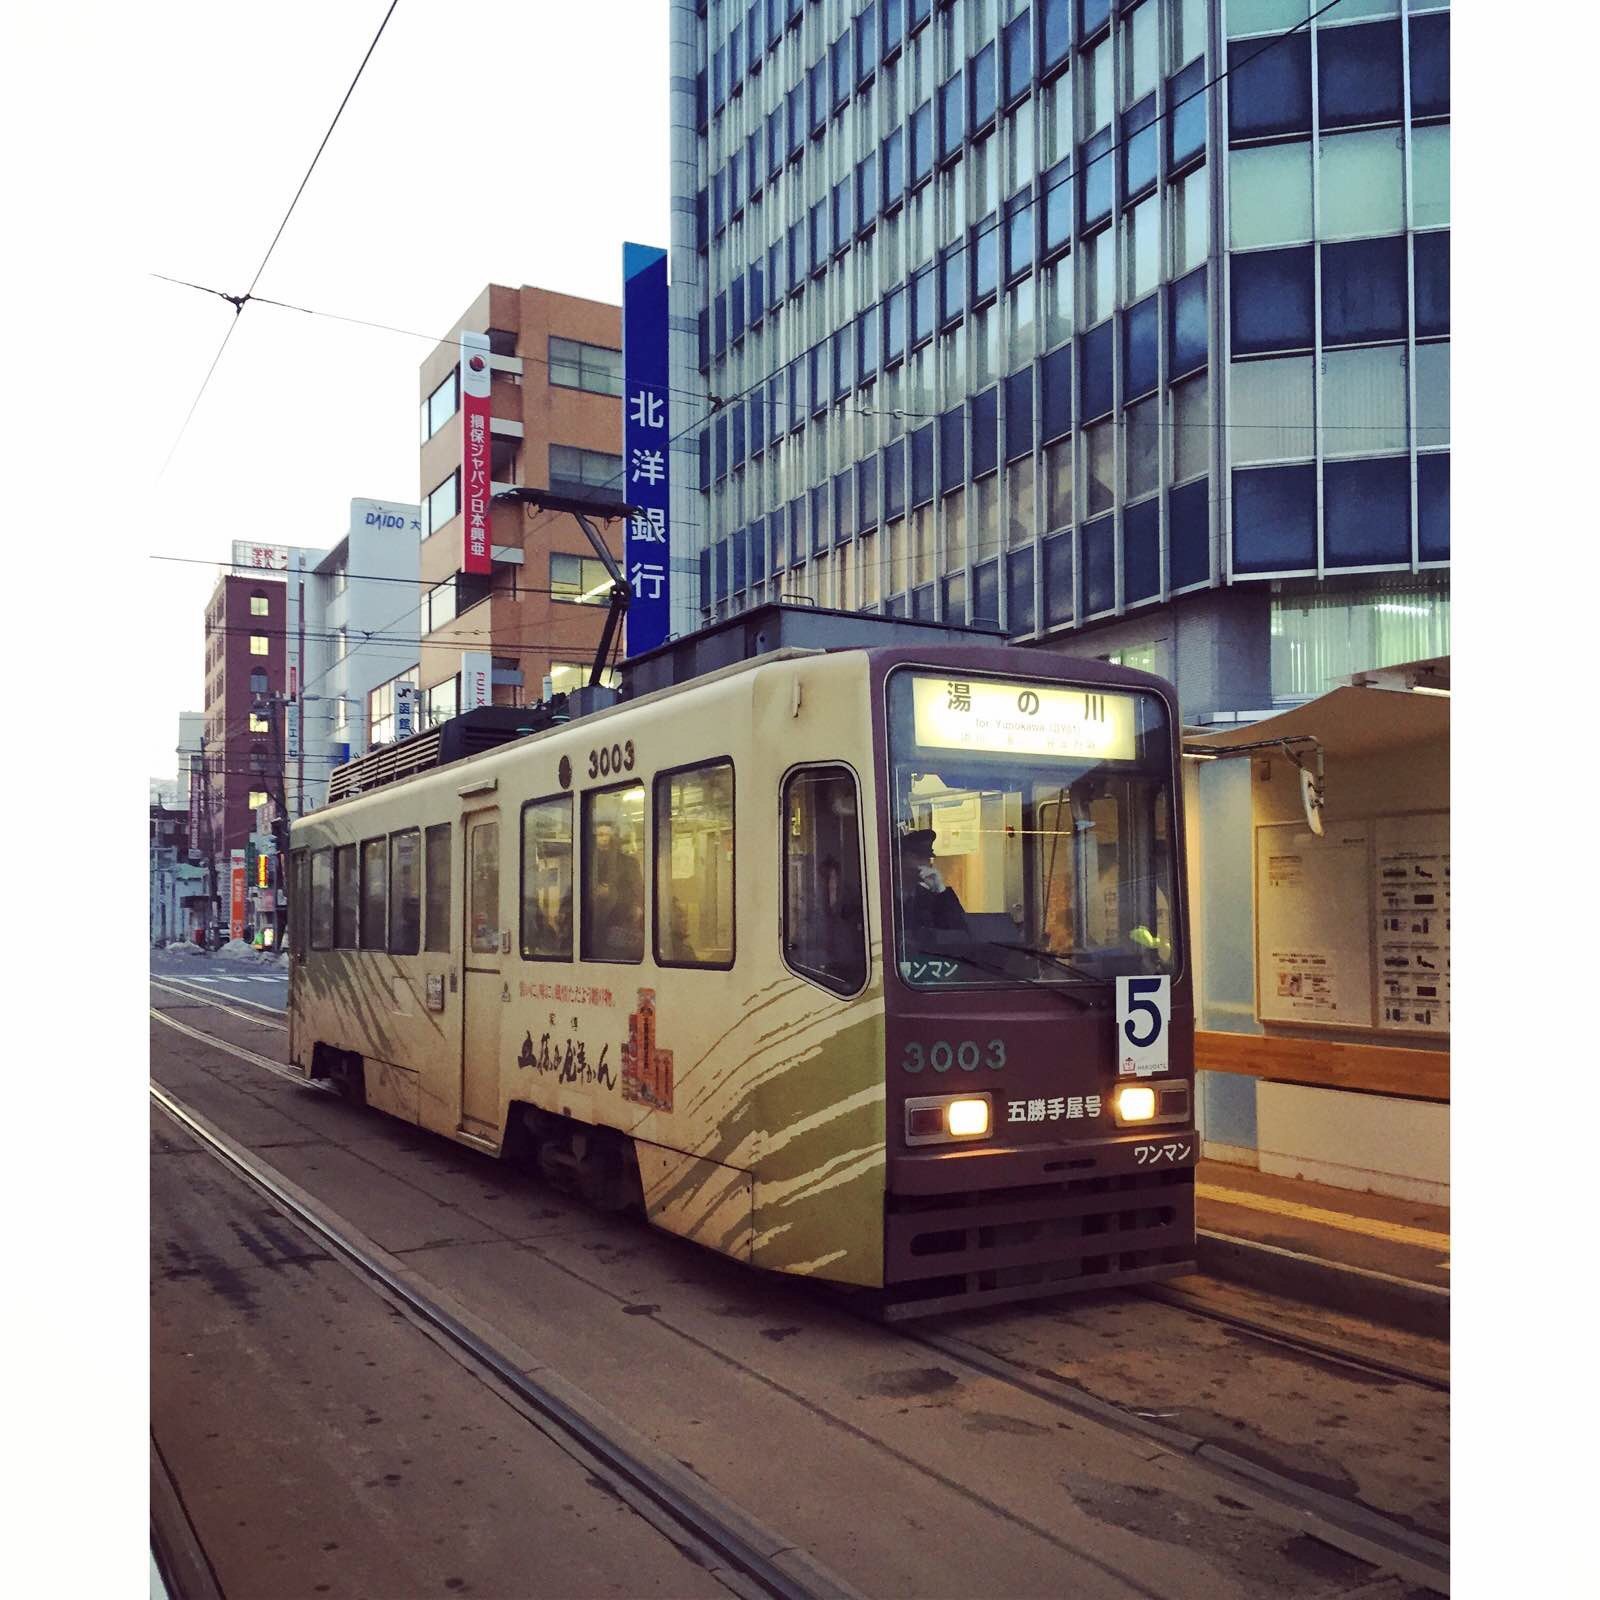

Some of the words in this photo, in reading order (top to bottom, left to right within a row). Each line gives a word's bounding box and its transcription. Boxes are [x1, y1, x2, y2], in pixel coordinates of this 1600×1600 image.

[470, 414, 485, 556] 損保ジャパン日本興亜
[630, 391, 666, 599] 北洋銀行
[366, 512, 404, 530] DAIDO
[947, 682, 1105, 722] 湯の川
[588, 740, 634, 779] 3003
[1124, 978, 1162, 1047] 5
[902, 1039, 1007, 1073] 3003
[1007, 1095, 1102, 1122] 五勝手屋号
[1134, 1142, 1191, 1164] ワンマン
